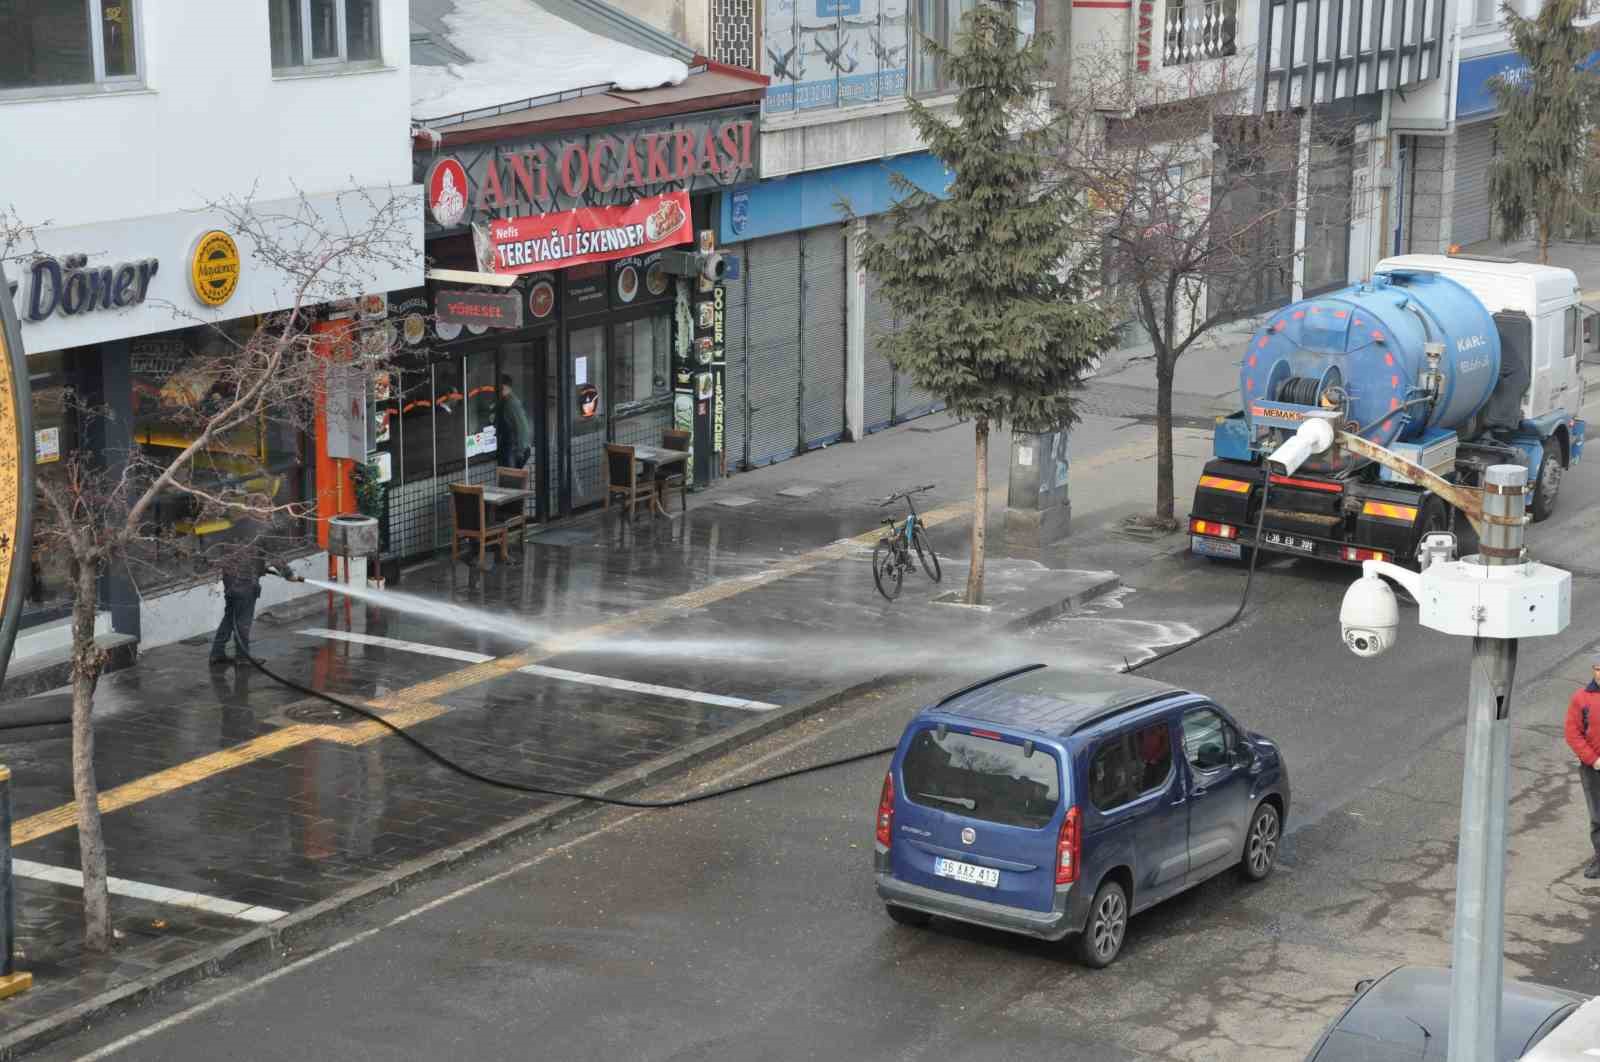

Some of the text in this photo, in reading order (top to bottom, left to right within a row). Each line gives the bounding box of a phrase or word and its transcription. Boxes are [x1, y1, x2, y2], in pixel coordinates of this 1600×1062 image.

[561, 120, 752, 197] OCAKBAŞI
[496, 226, 519, 240] Nefis
[497, 229, 574, 268] TEREYAĞLI
[575, 223, 645, 256] İSKENDER
[29, 253, 159, 322] Döner
[942, 860, 998, 883] 36 AAZ 413
